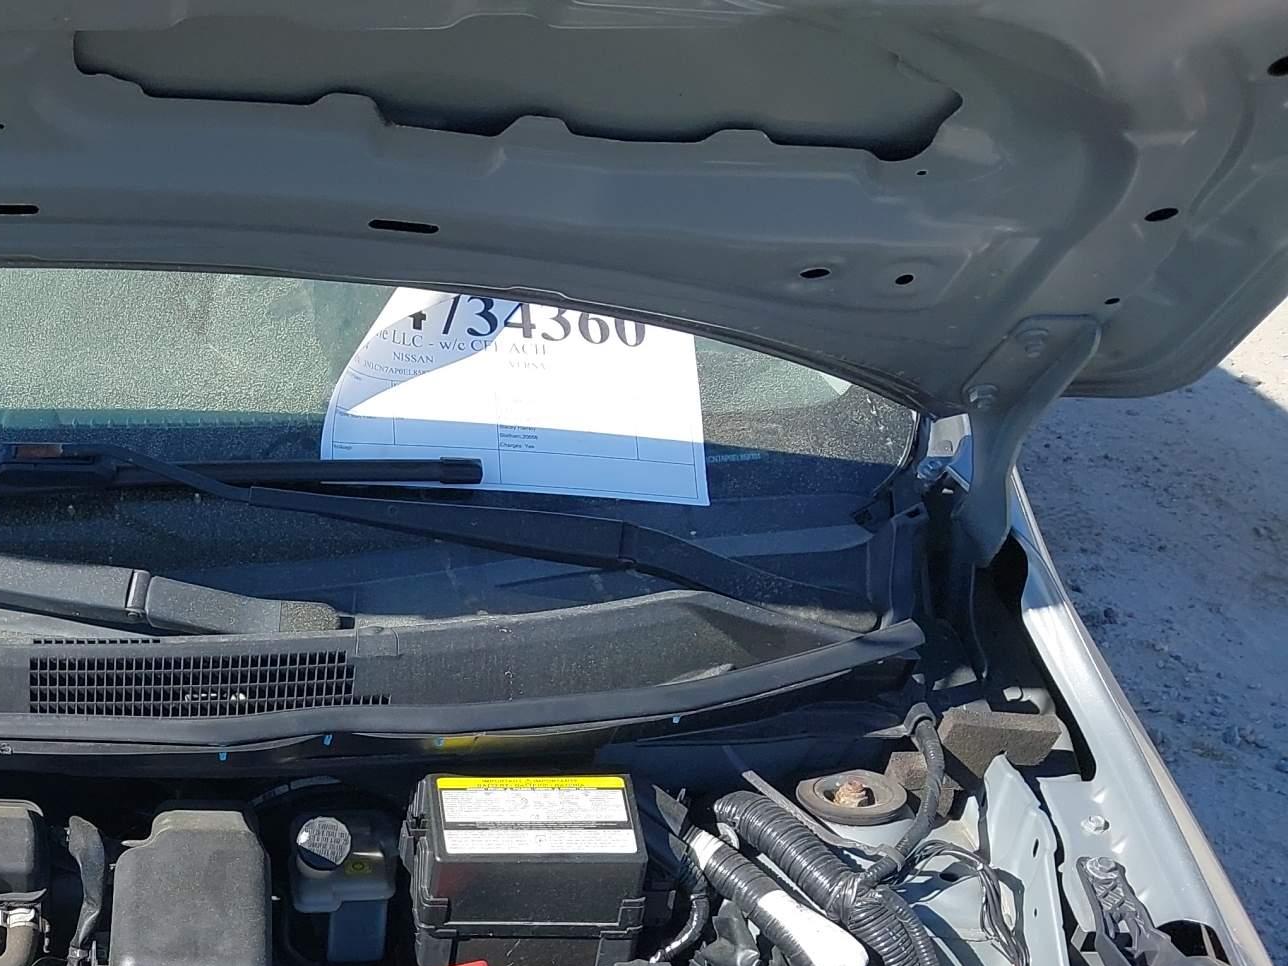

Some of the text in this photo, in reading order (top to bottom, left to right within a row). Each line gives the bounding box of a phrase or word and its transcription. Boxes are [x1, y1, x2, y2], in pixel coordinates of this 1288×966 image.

[392, 329, 423, 348] LLC
[439, 338, 465, 351] w/c
[393, 351, 434, 364] NISSAN
